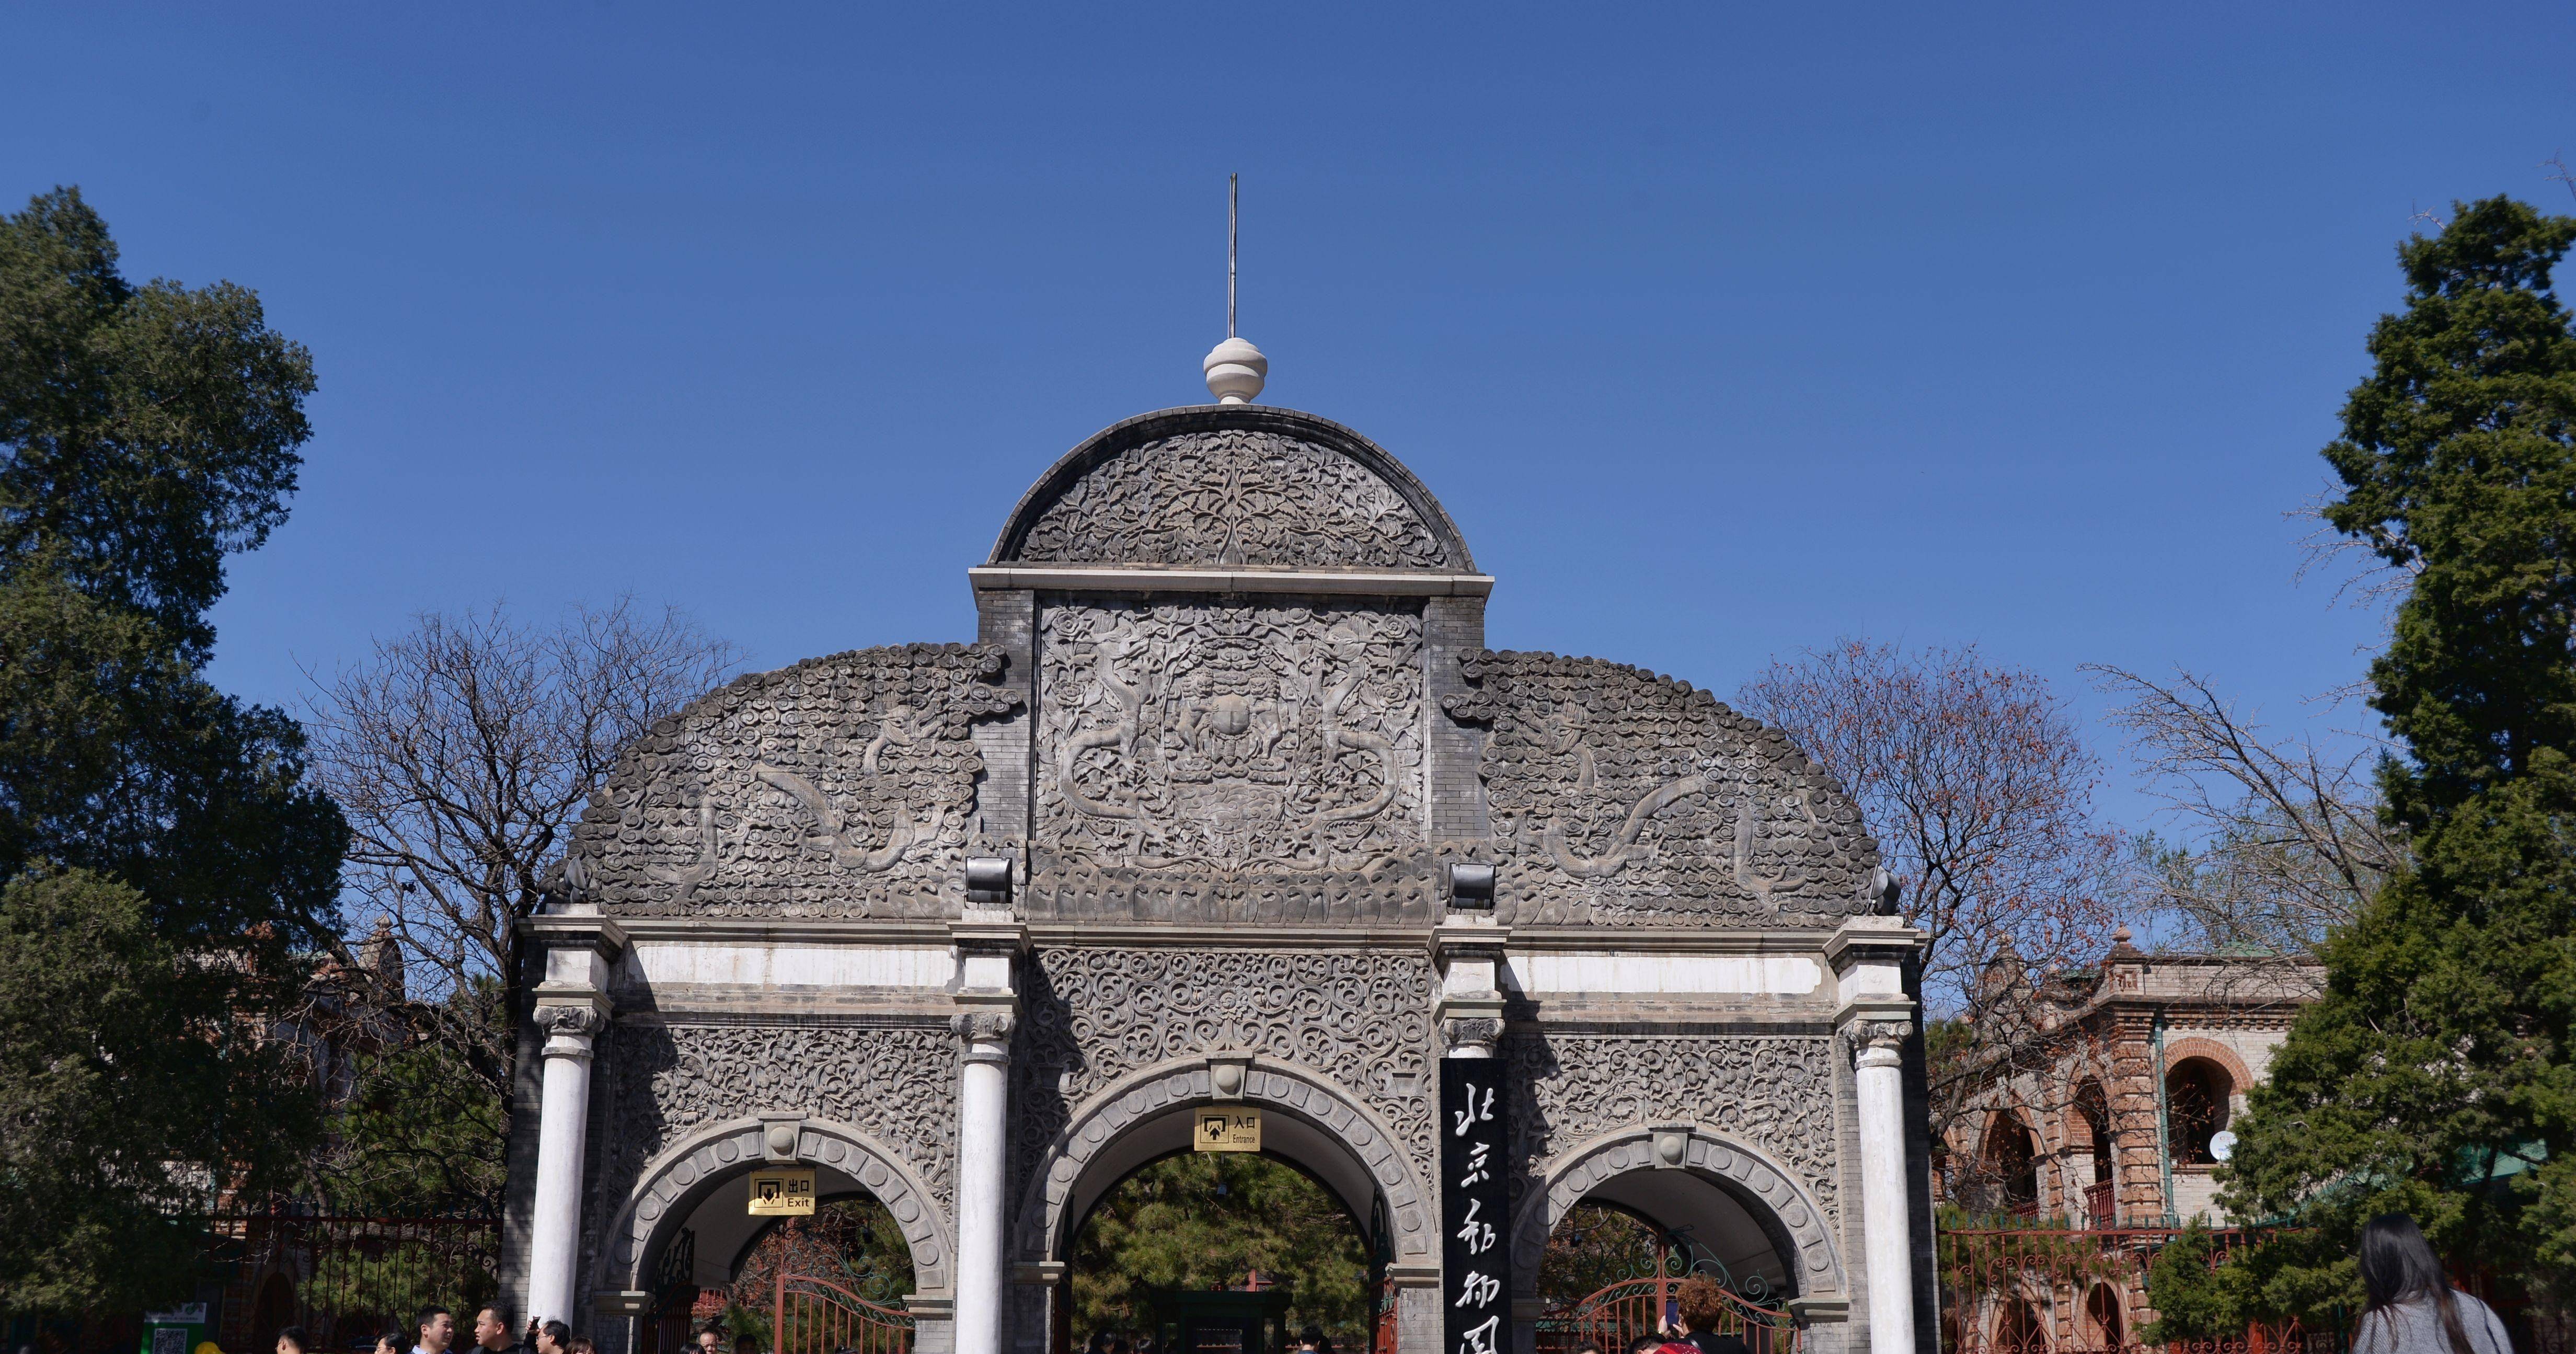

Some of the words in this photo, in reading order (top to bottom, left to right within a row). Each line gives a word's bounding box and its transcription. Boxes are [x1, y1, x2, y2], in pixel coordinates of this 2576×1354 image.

[1234, 1116, 1255, 1129] 入口
[1233, 1134, 1255, 1143] Entrance
[788, 1178, 809, 1193] 出口
[788, 1198, 809, 1207] Exit
